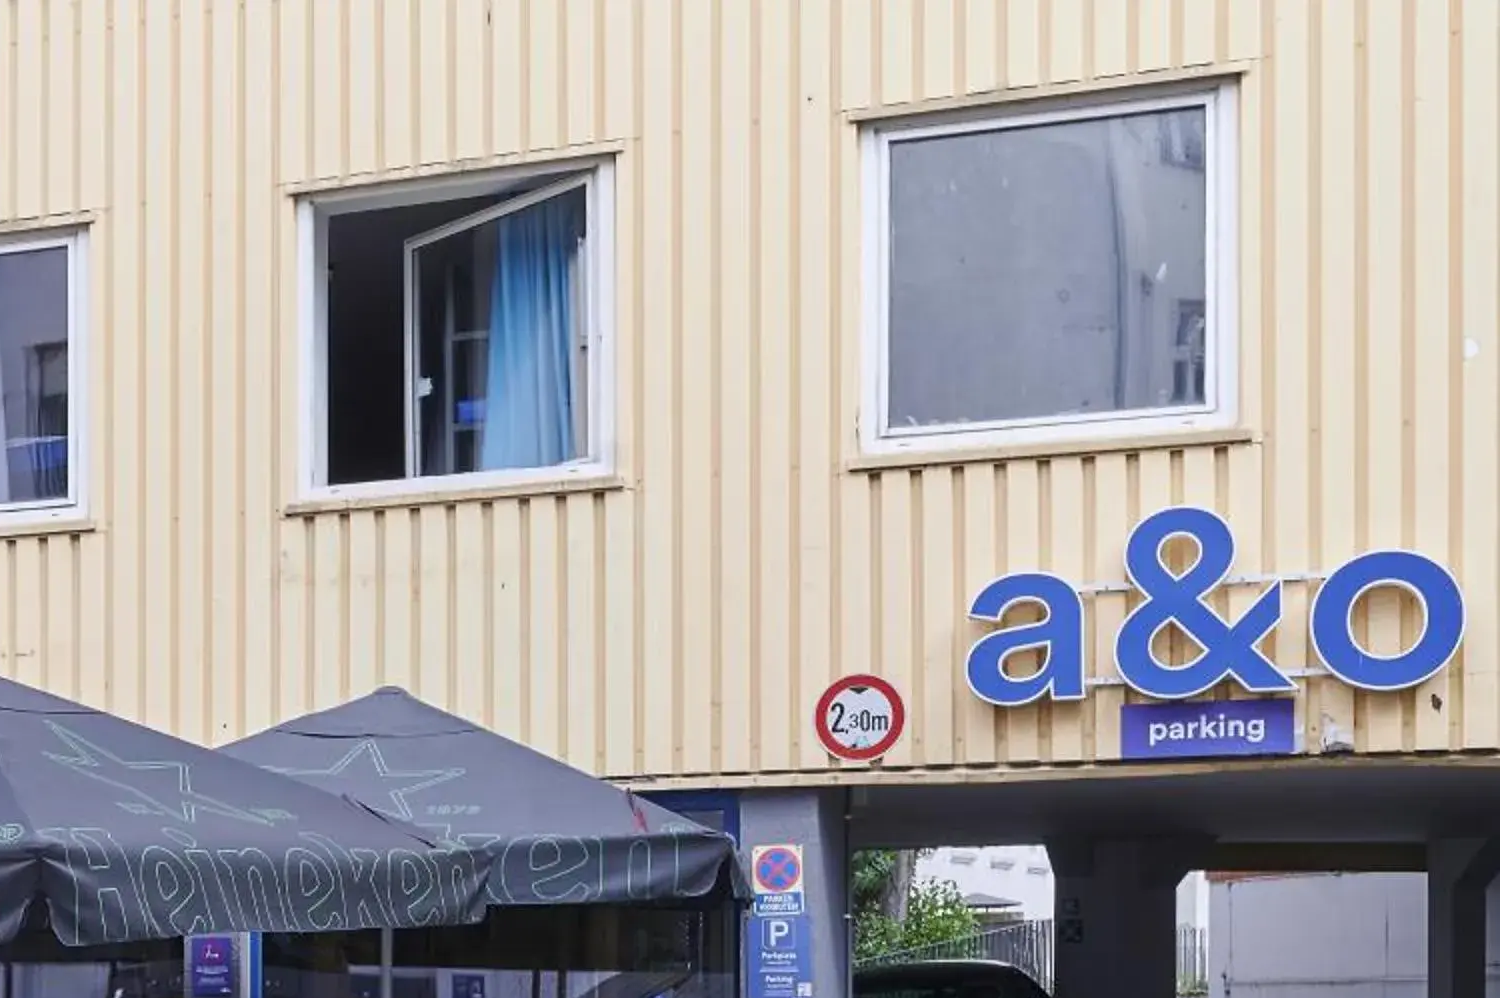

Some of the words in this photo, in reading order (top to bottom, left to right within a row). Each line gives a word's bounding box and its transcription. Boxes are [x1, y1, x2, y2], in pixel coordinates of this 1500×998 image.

[966, 506, 1466, 706] a&o
[1149, 713, 1266, 746] parking
[37, 827, 490, 945] Heineken
[769, 921, 789, 947] P
